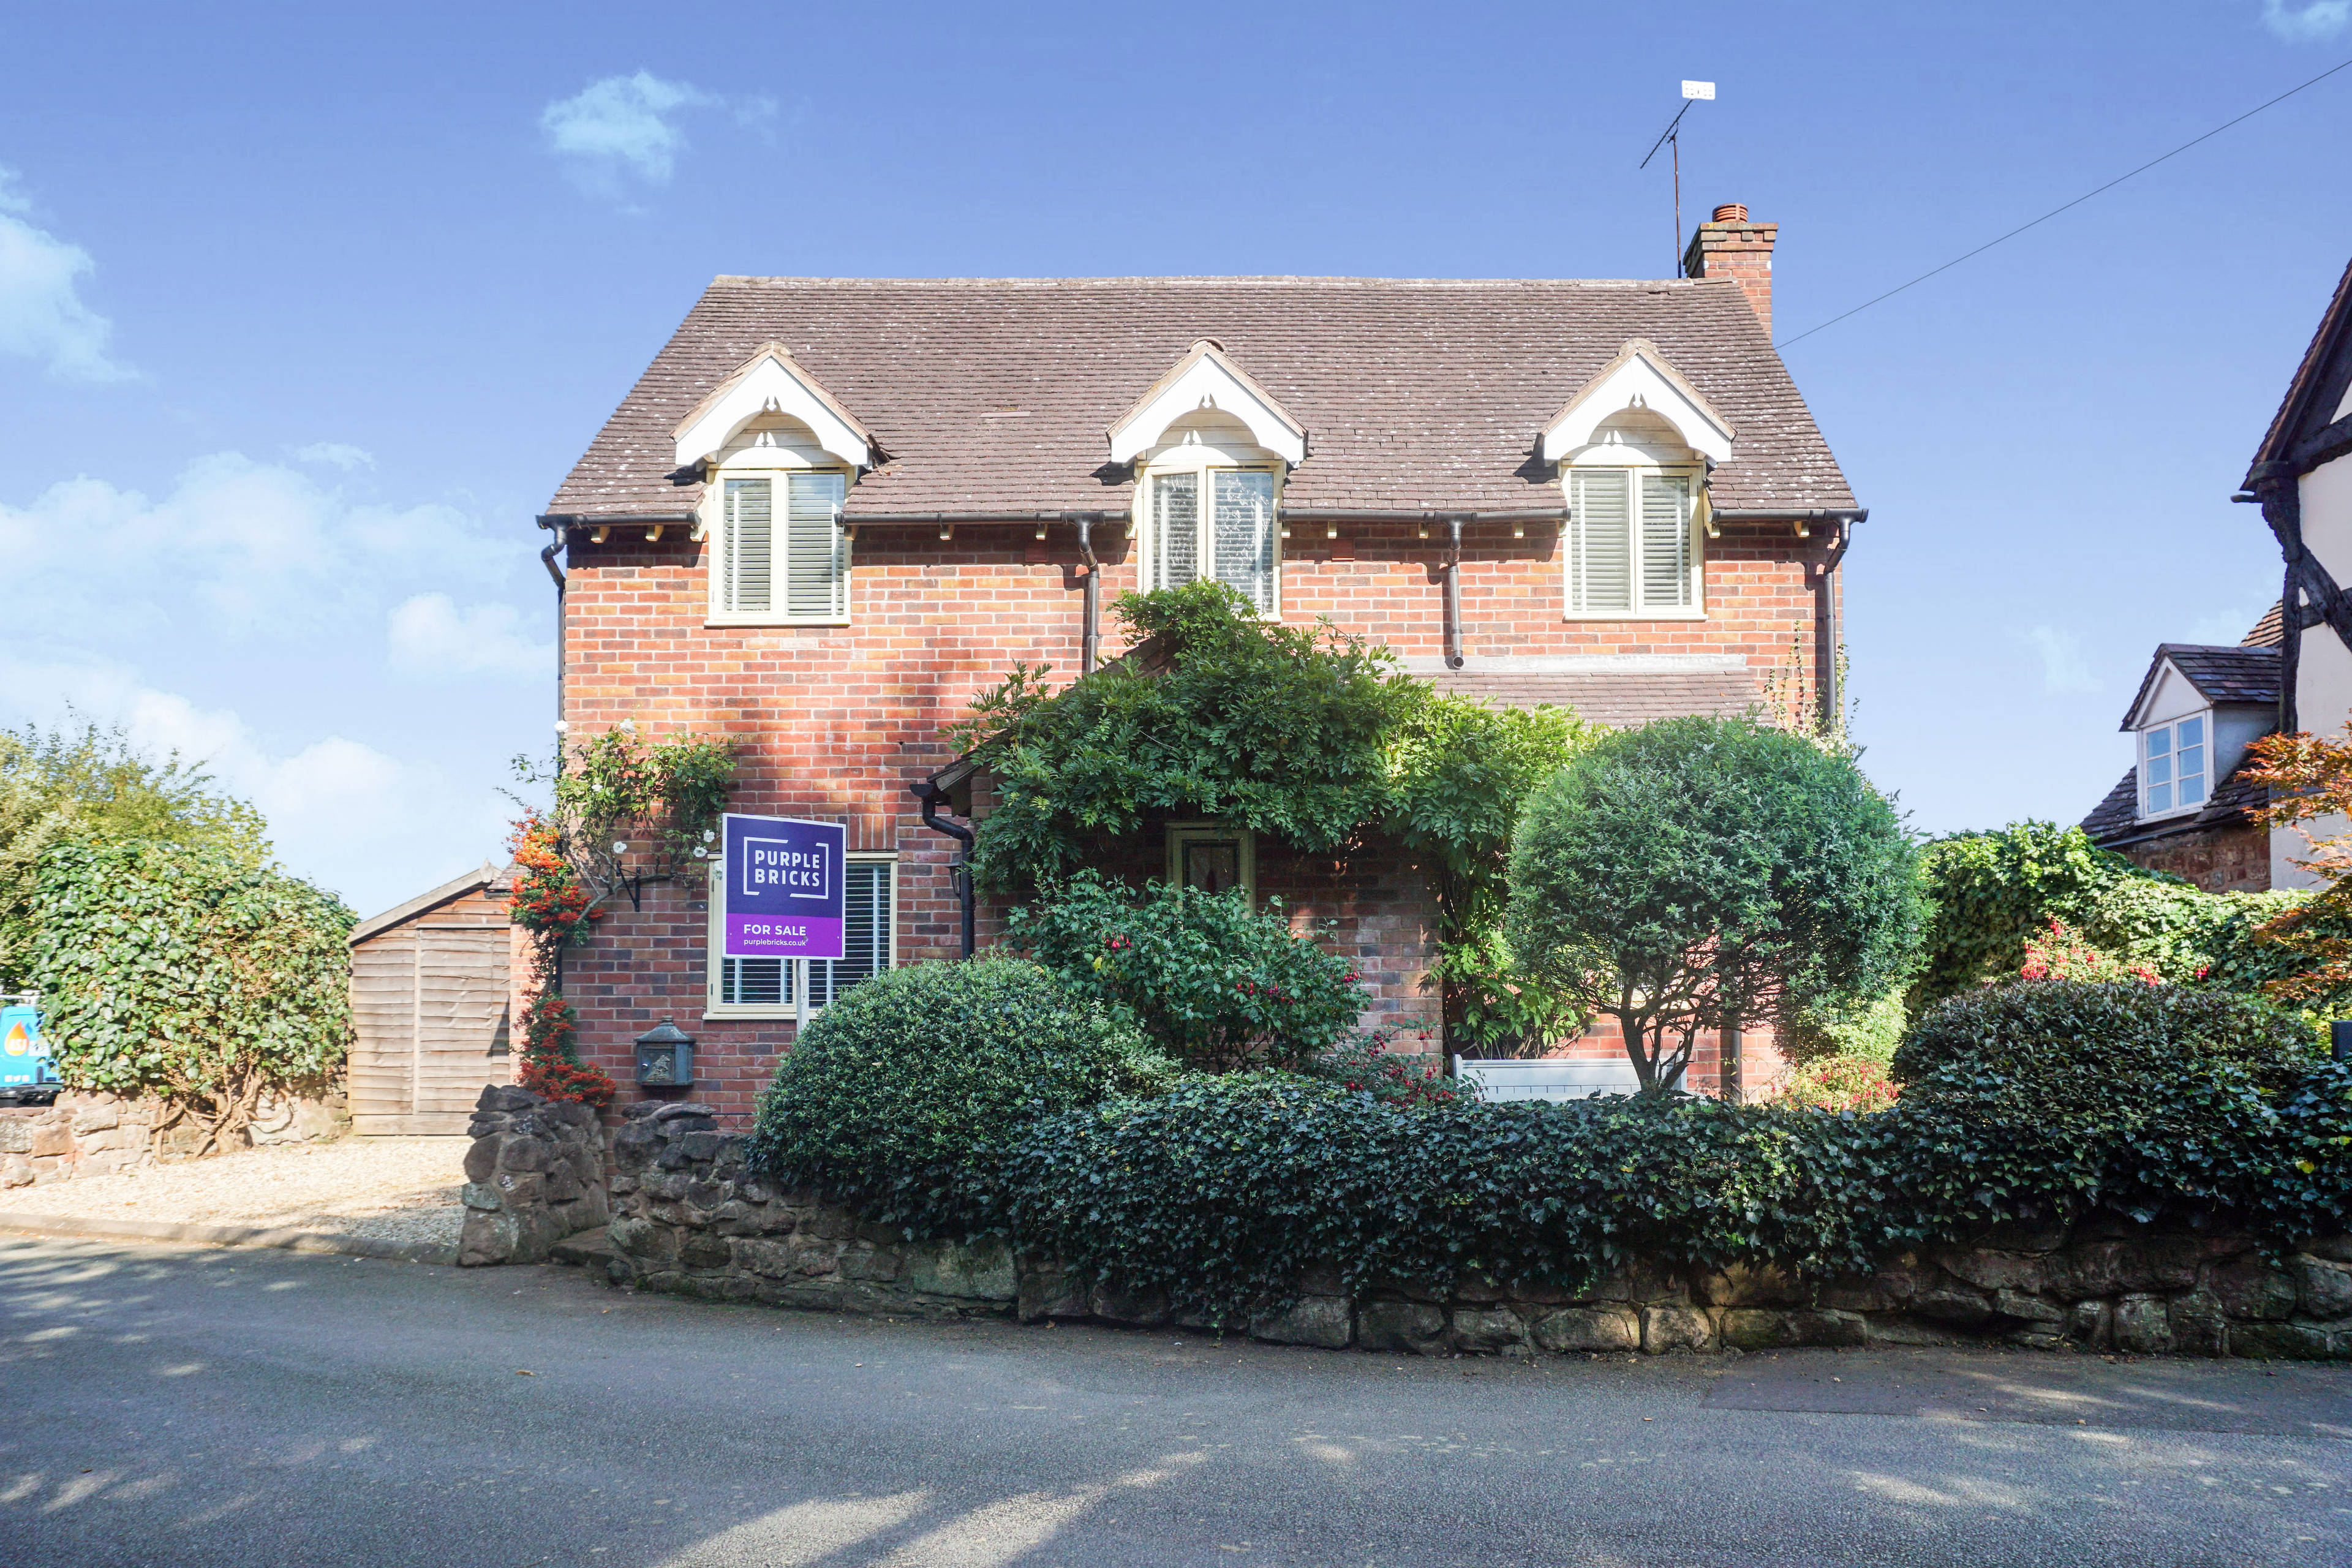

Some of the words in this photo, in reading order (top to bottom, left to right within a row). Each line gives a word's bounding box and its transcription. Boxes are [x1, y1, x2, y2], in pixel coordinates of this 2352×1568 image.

[755, 850, 820, 869] PURPLE
[755, 869, 820, 886] BRICKS
[744, 924, 771, 935] FOR
[775, 925, 806, 936] SALE
